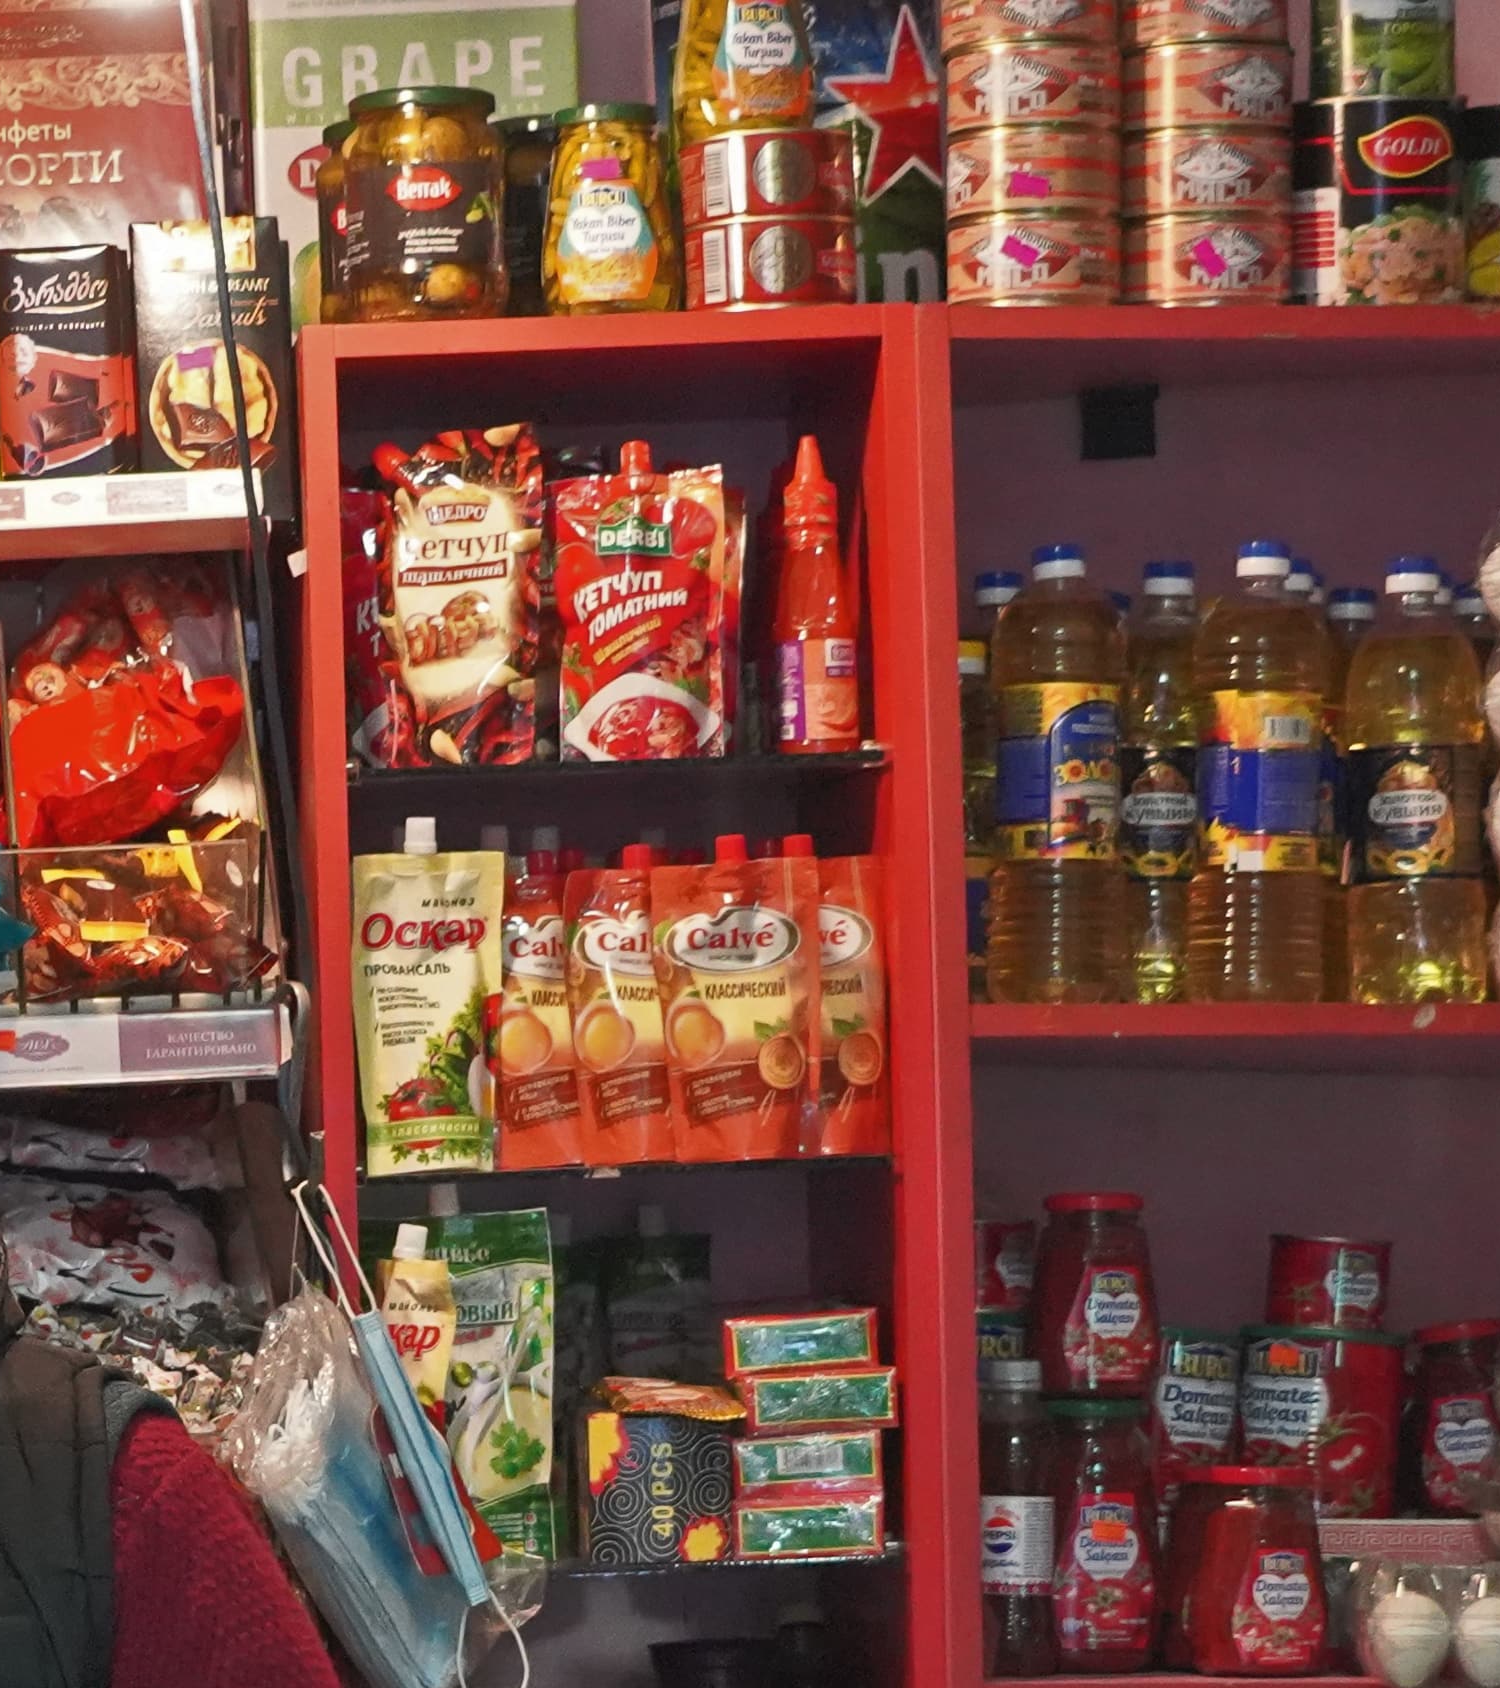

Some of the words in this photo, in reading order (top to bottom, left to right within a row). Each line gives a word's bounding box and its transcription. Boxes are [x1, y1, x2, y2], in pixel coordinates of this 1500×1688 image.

[281, 36, 546, 108] GRAPE
[1374, 134, 1443, 159] GOLDI
[606, 214, 637, 229] Biber
[222, 277, 271, 293] REAMY
[600, 528, 667, 549] DERBI
[573, 570, 663, 621] КЕТЧУП
[587, 587, 689, 645] ТОМАТНИЙ
[360, 911, 487, 953] Оскар
[599, 931, 652, 954] Cal
[687, 921, 777, 952] Calvé
[363, 962, 451, 980] ПРОВАНСАЛЬ
[615, 986, 662, 1004] КЛАССИЧ
[704, 979, 786, 999] КЛАССИЧЕСКИЙ
[167, 1030, 236, 1045] КАЧЕСТВО
[145, 1042, 257, 1059] ГАРАНТИРОВАНО
[389, 1322, 442, 1358] кар
[650, 1440, 675, 1496] PCS
[650, 1503, 676, 1539] 40
[983, 1529, 1017, 1542] PEPSI
